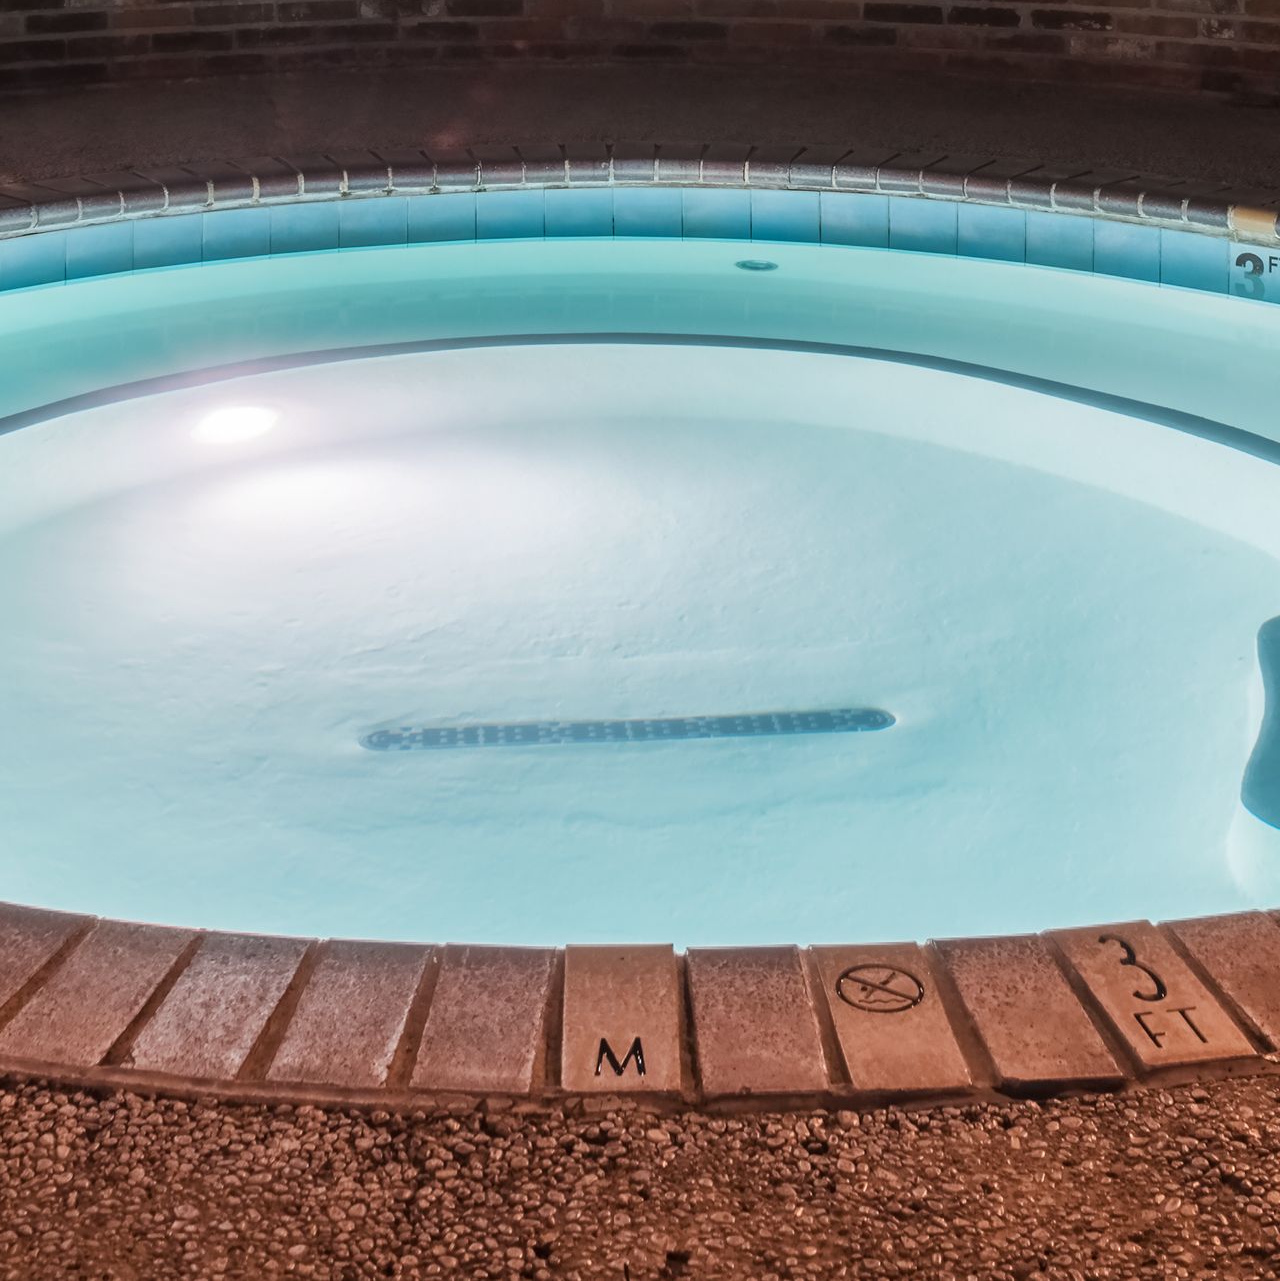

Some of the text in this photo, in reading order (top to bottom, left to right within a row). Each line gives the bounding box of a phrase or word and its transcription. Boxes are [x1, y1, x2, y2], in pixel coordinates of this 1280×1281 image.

[1234, 252, 1265, 301] 3
[1098, 934, 1167, 1001] 3
[1133, 1006, 1208, 1048] FT
[594, 1036, 646, 1076] M
